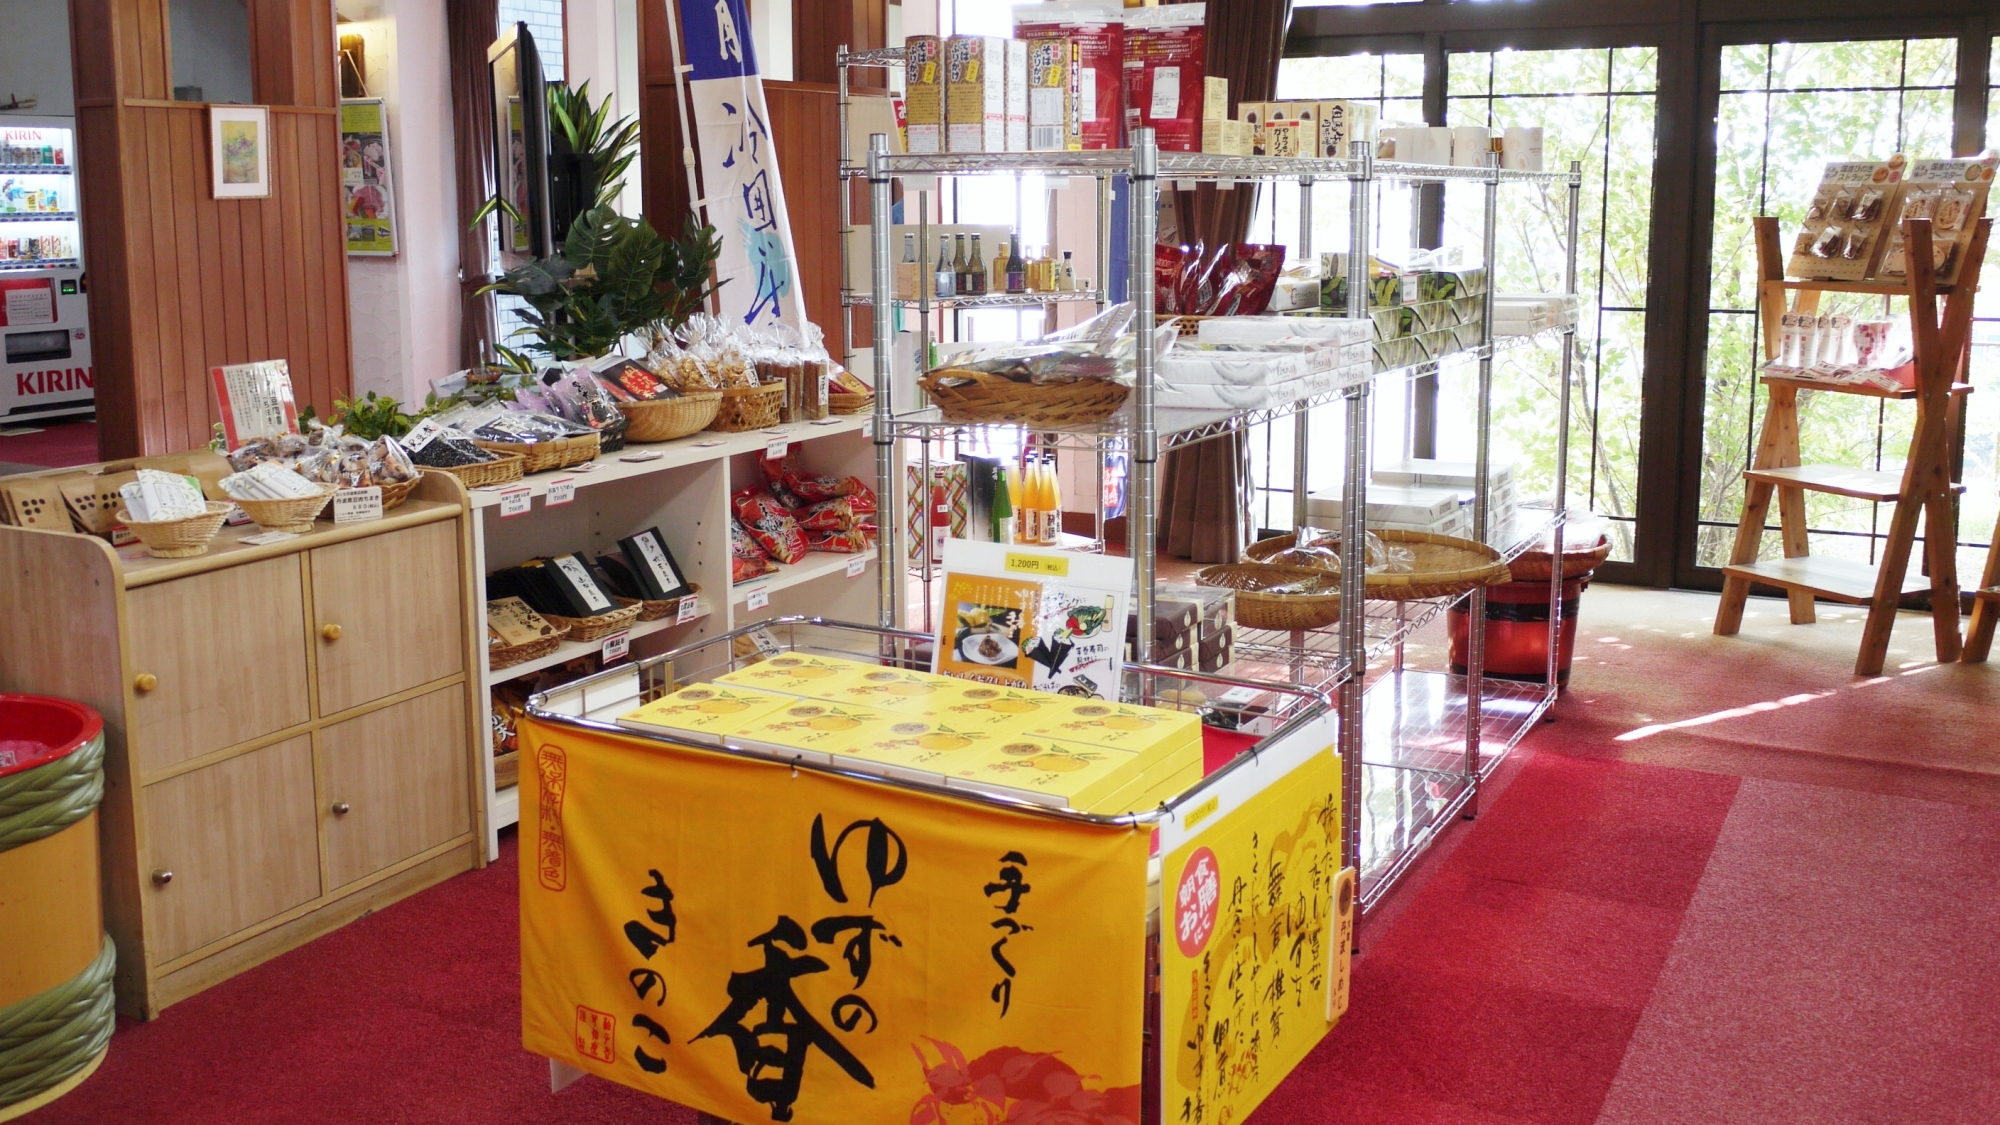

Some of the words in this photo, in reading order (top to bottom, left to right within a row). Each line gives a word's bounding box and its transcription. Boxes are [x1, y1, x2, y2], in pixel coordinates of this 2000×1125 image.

[908, 46, 917, 82] ふりかけ
[917, 40, 927, 62] そば
[951, 45, 960, 82] ふりかけ
[960, 39, 970, 61] そば
[1042, 44, 1052, 66] そば
[1033, 50, 1042, 85] ふりかけ
[5, 129, 42, 141] KIRIN
[1837, 172, 1873, 182] ストラップ
[1928, 171, 1963, 180] コースター
[16, 366, 94, 396] KIRIN
[336, 495, 379, 504] 丹波黒豆肉ちまき
[1010, 558, 1040, 570] 1,200円
[1075, 644, 1109, 656] 手巻寿司の
[1179, 856, 1210, 908] 朝食
[1180, 872, 1218, 941] お膳
[809, 812, 908, 1035] ゆずの
[983, 851, 1034, 1019] 手づくり
[1193, 913, 1211, 945] にて
[623, 869, 676, 1075] きのこ
[688, 914, 876, 1123] 香
